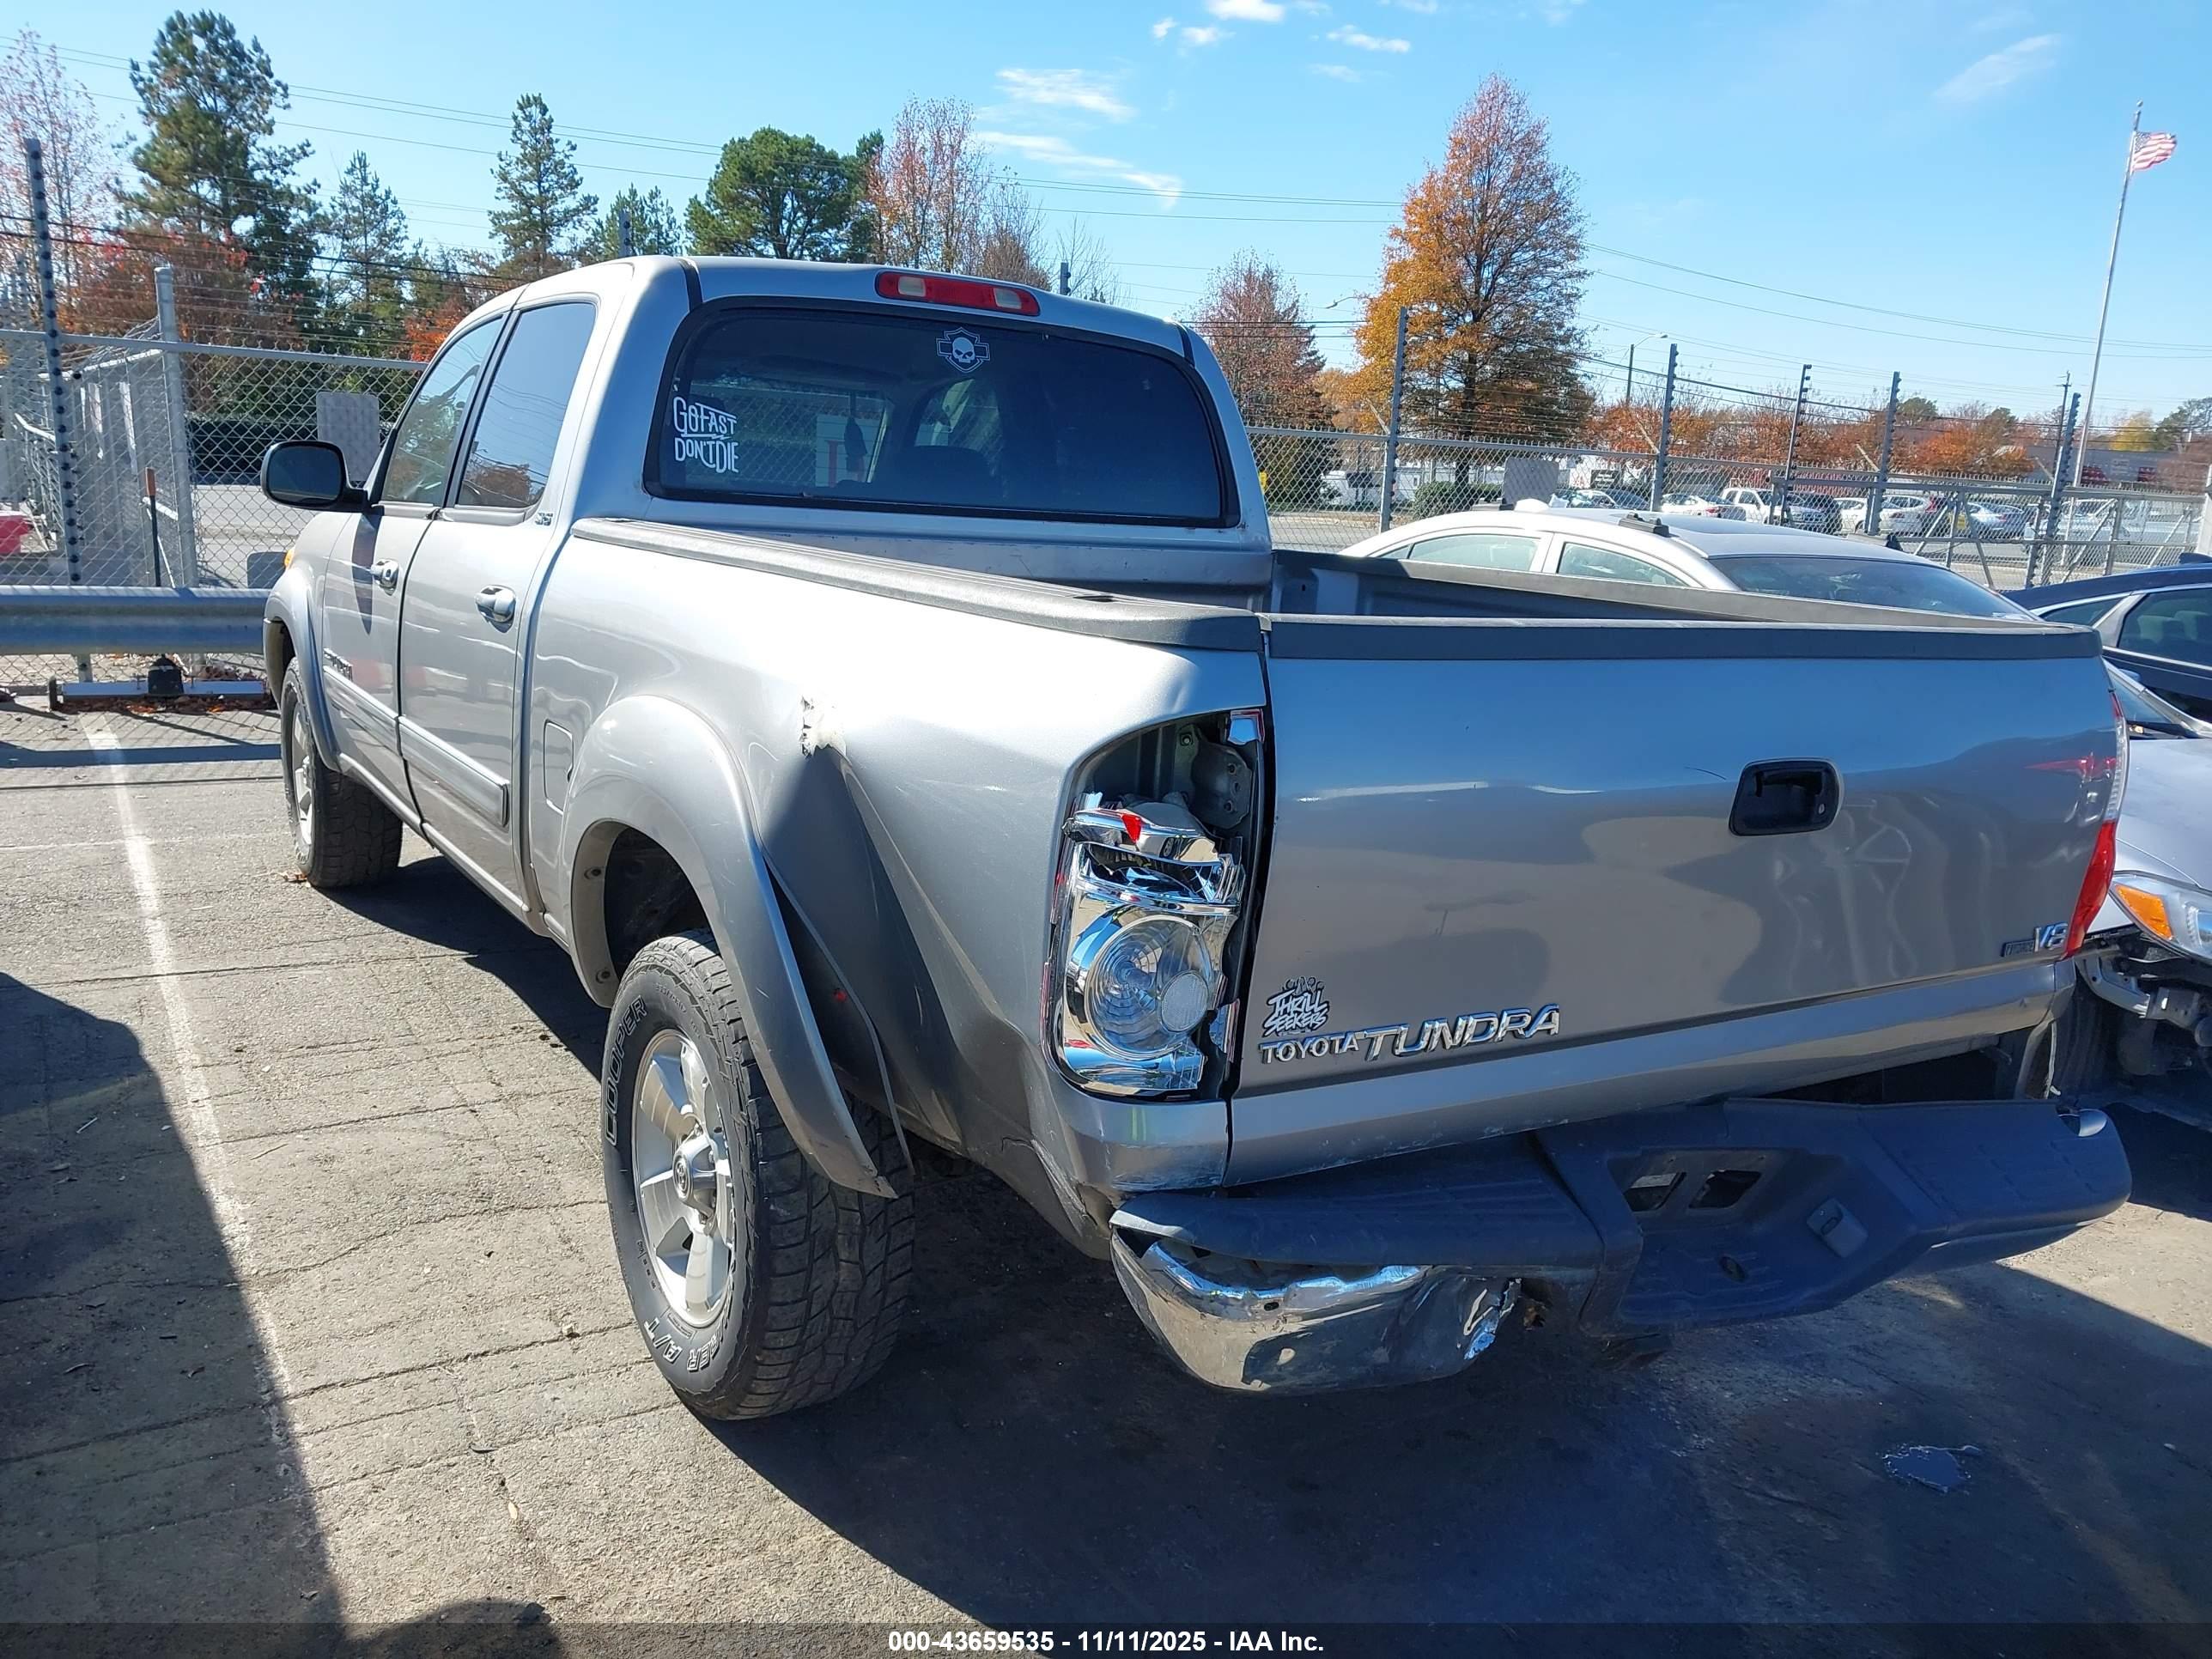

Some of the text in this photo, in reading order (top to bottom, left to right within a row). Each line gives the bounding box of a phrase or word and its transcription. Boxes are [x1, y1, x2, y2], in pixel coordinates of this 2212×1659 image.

[673, 396, 738, 435] GO FAST
[674, 437, 739, 474] DON'T DIE
[1262, 1008, 1329, 1037] SEEKERS
[1267, 988, 1329, 1018] THRILL
[1260, 1003, 1560, 1064] TOYOTA TUNDRA
[605, 994, 648, 1146] COOPER
[643, 1317, 683, 1364] A/T
